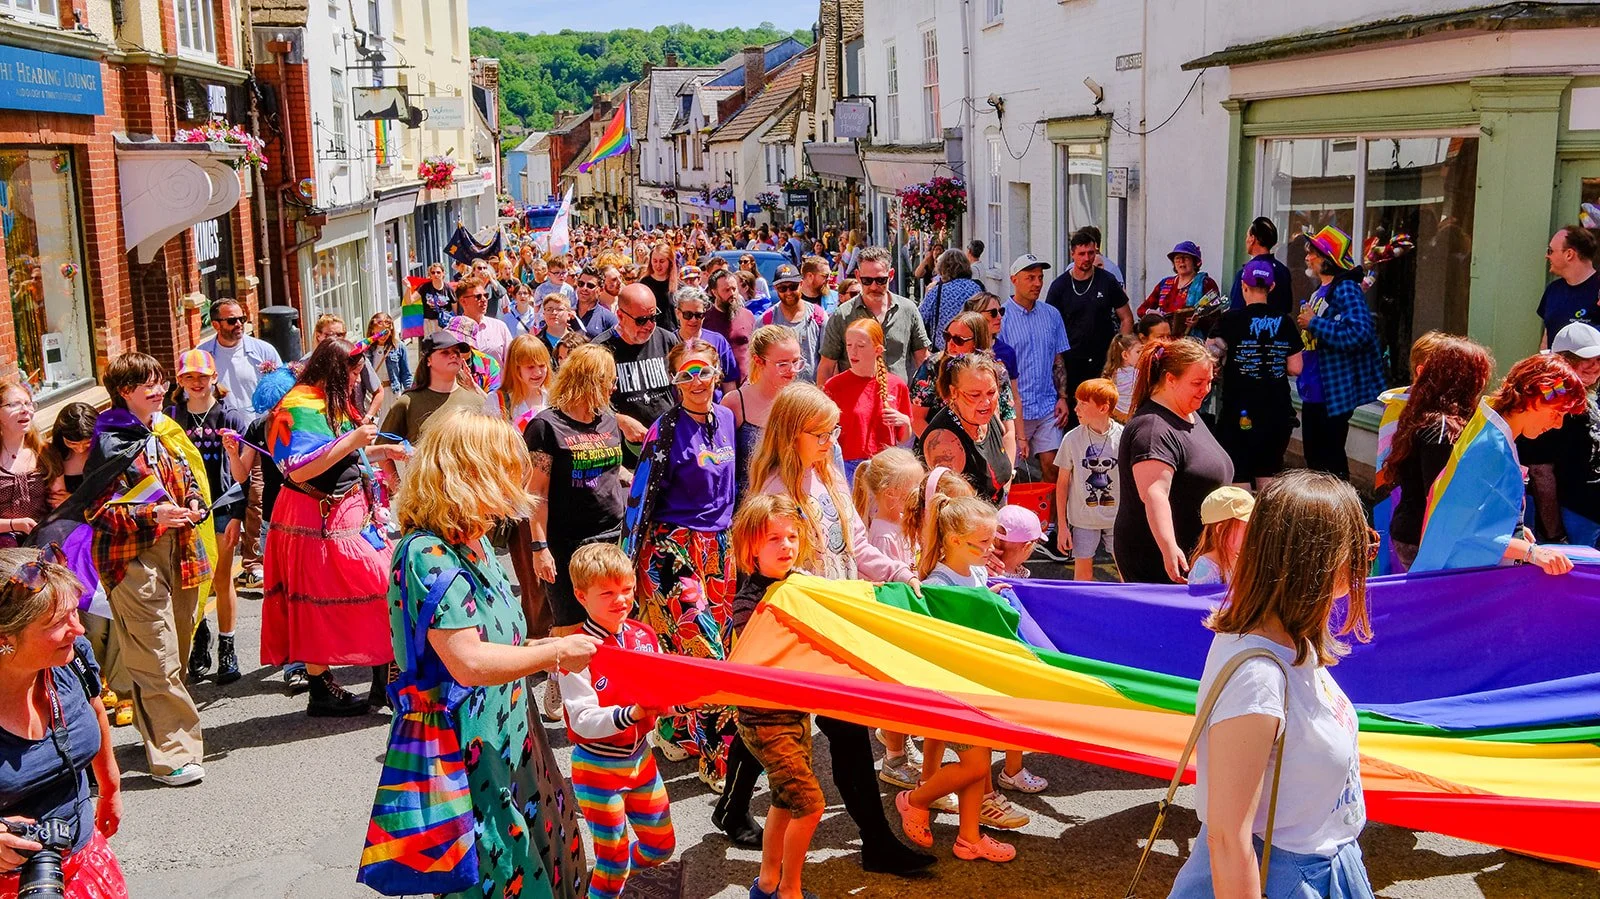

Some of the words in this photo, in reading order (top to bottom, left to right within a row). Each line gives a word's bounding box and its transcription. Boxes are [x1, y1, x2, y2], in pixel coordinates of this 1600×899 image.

[1117, 57, 1128, 69] LONG
[1129, 54, 1142, 67] STRE
[0, 62, 13, 80] HE
[16, 62, 60, 86] HEARING
[63, 69, 97, 91] LOUNGE
[839, 112, 864, 124] Loving
[840, 120, 862, 134] Home
[194, 219, 219, 262] KINGS
[616, 361, 641, 393] NEW
[639, 357, 669, 389] YORK
[564, 435, 577, 446] MY
[572, 450, 588, 460] THE
[589, 448, 606, 460] BOYS
[605, 447, 615, 457] TO
[572, 469, 583, 479] GO
[49, 690, 59, 719] Canon
